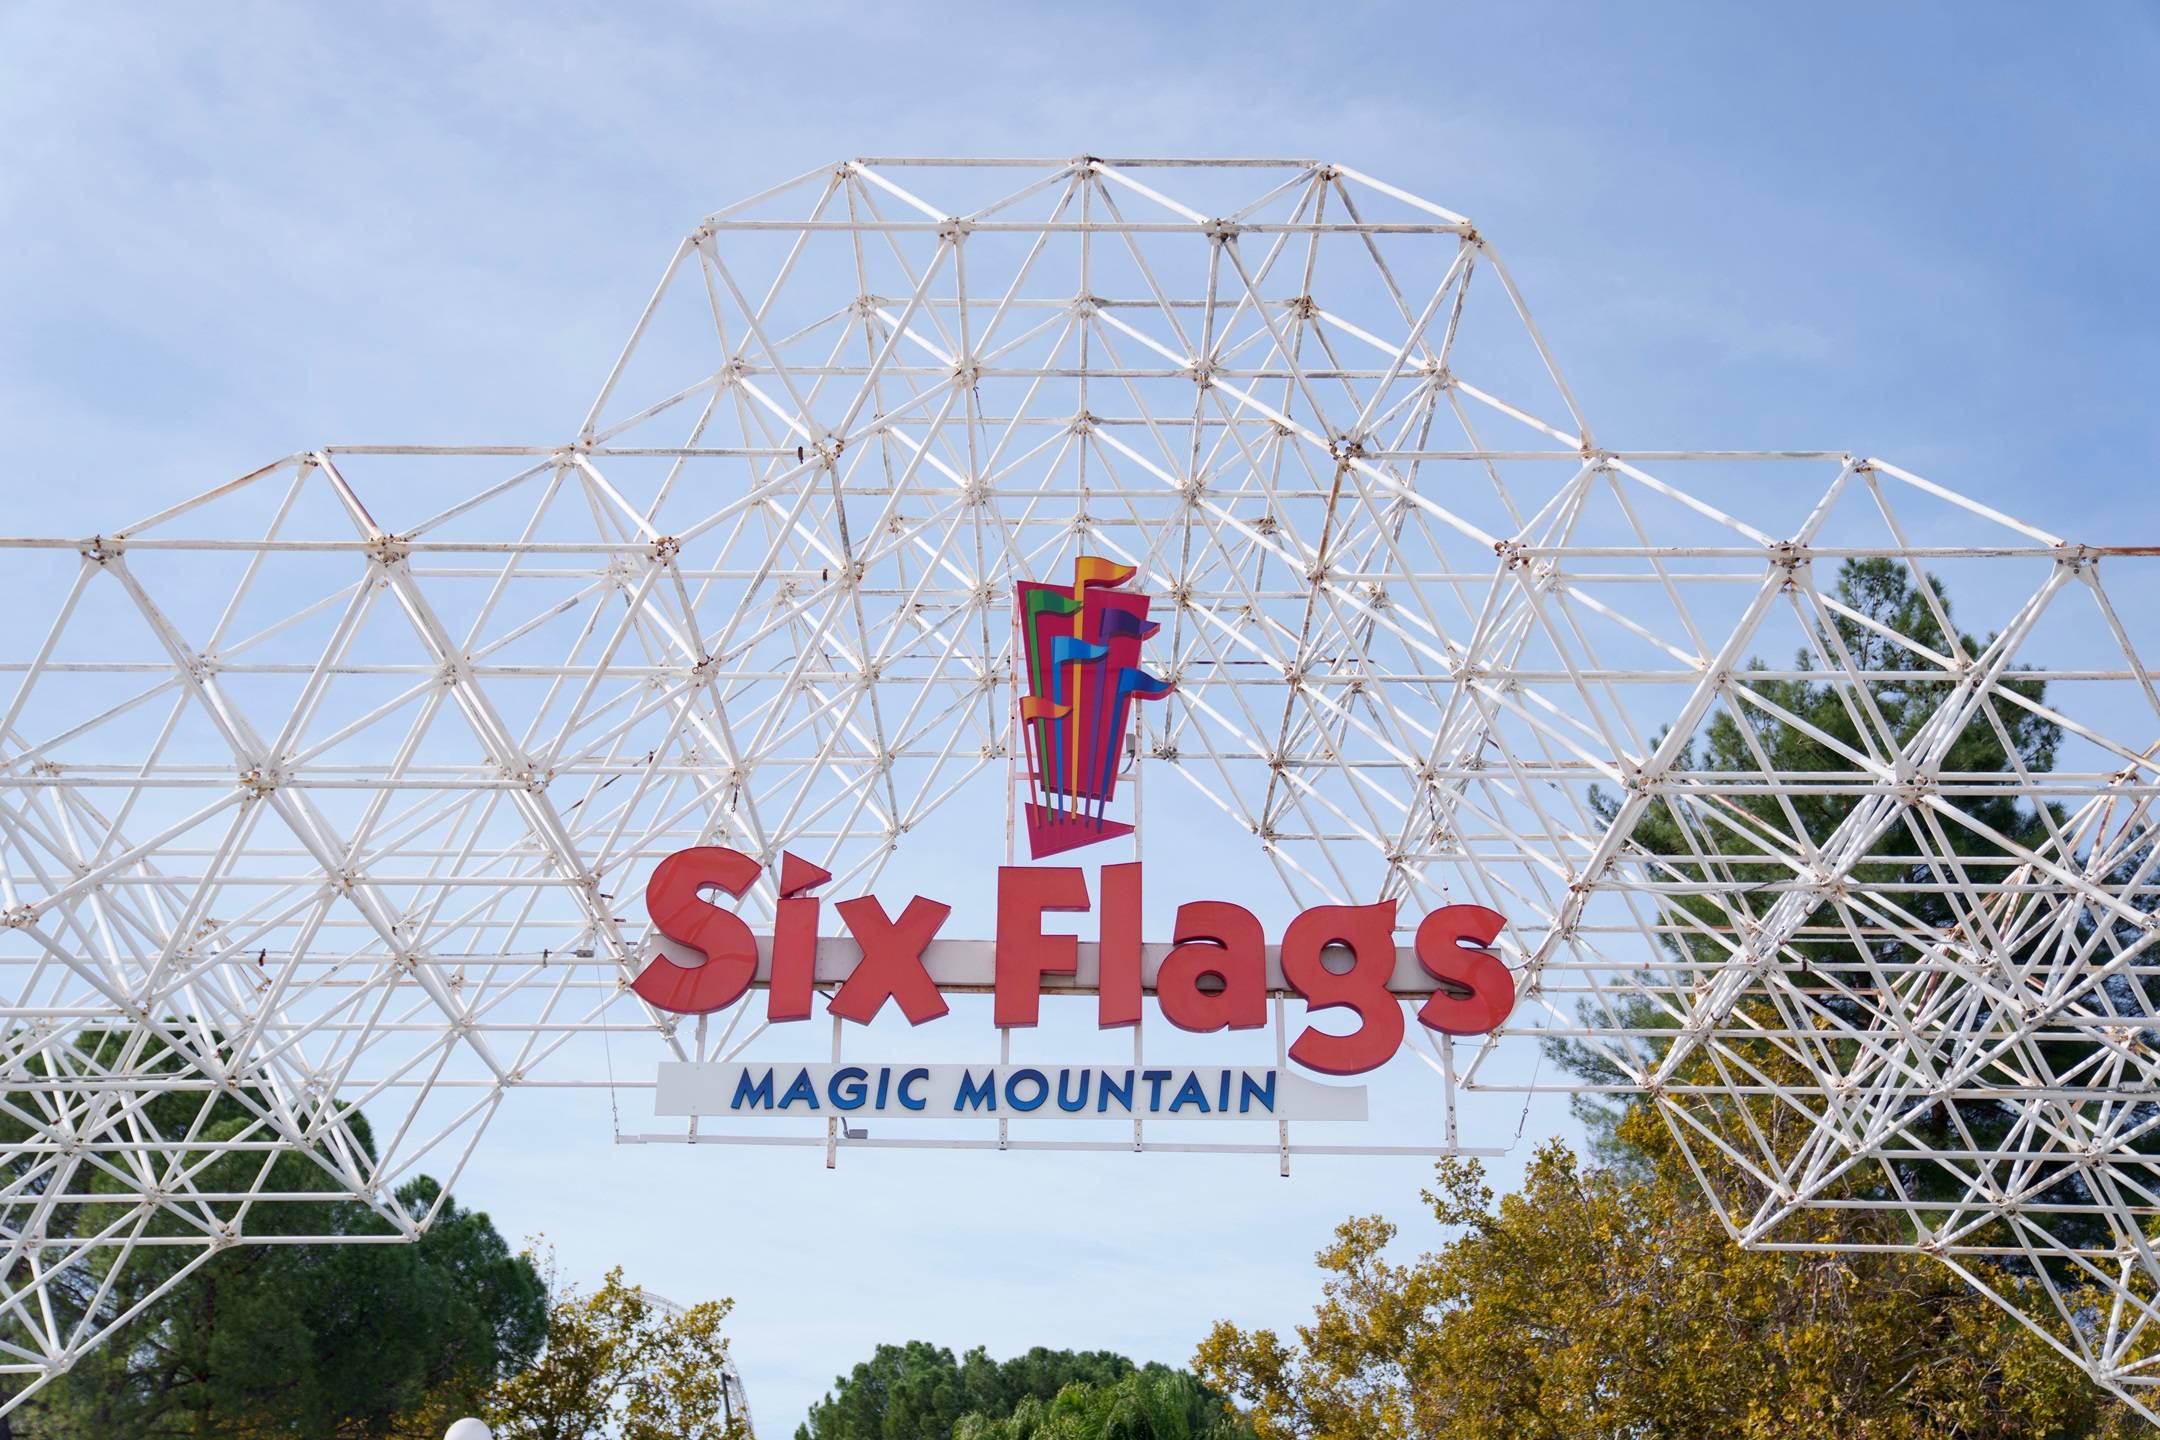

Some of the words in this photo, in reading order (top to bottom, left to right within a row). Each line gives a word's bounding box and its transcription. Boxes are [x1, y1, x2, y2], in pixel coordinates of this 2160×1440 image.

[632, 846, 951, 1026] Six
[995, 862, 1515, 1075] Flags
[731, 1067, 929, 1110] MAGIC
[954, 1069, 1277, 1113] MOUNTAIN
